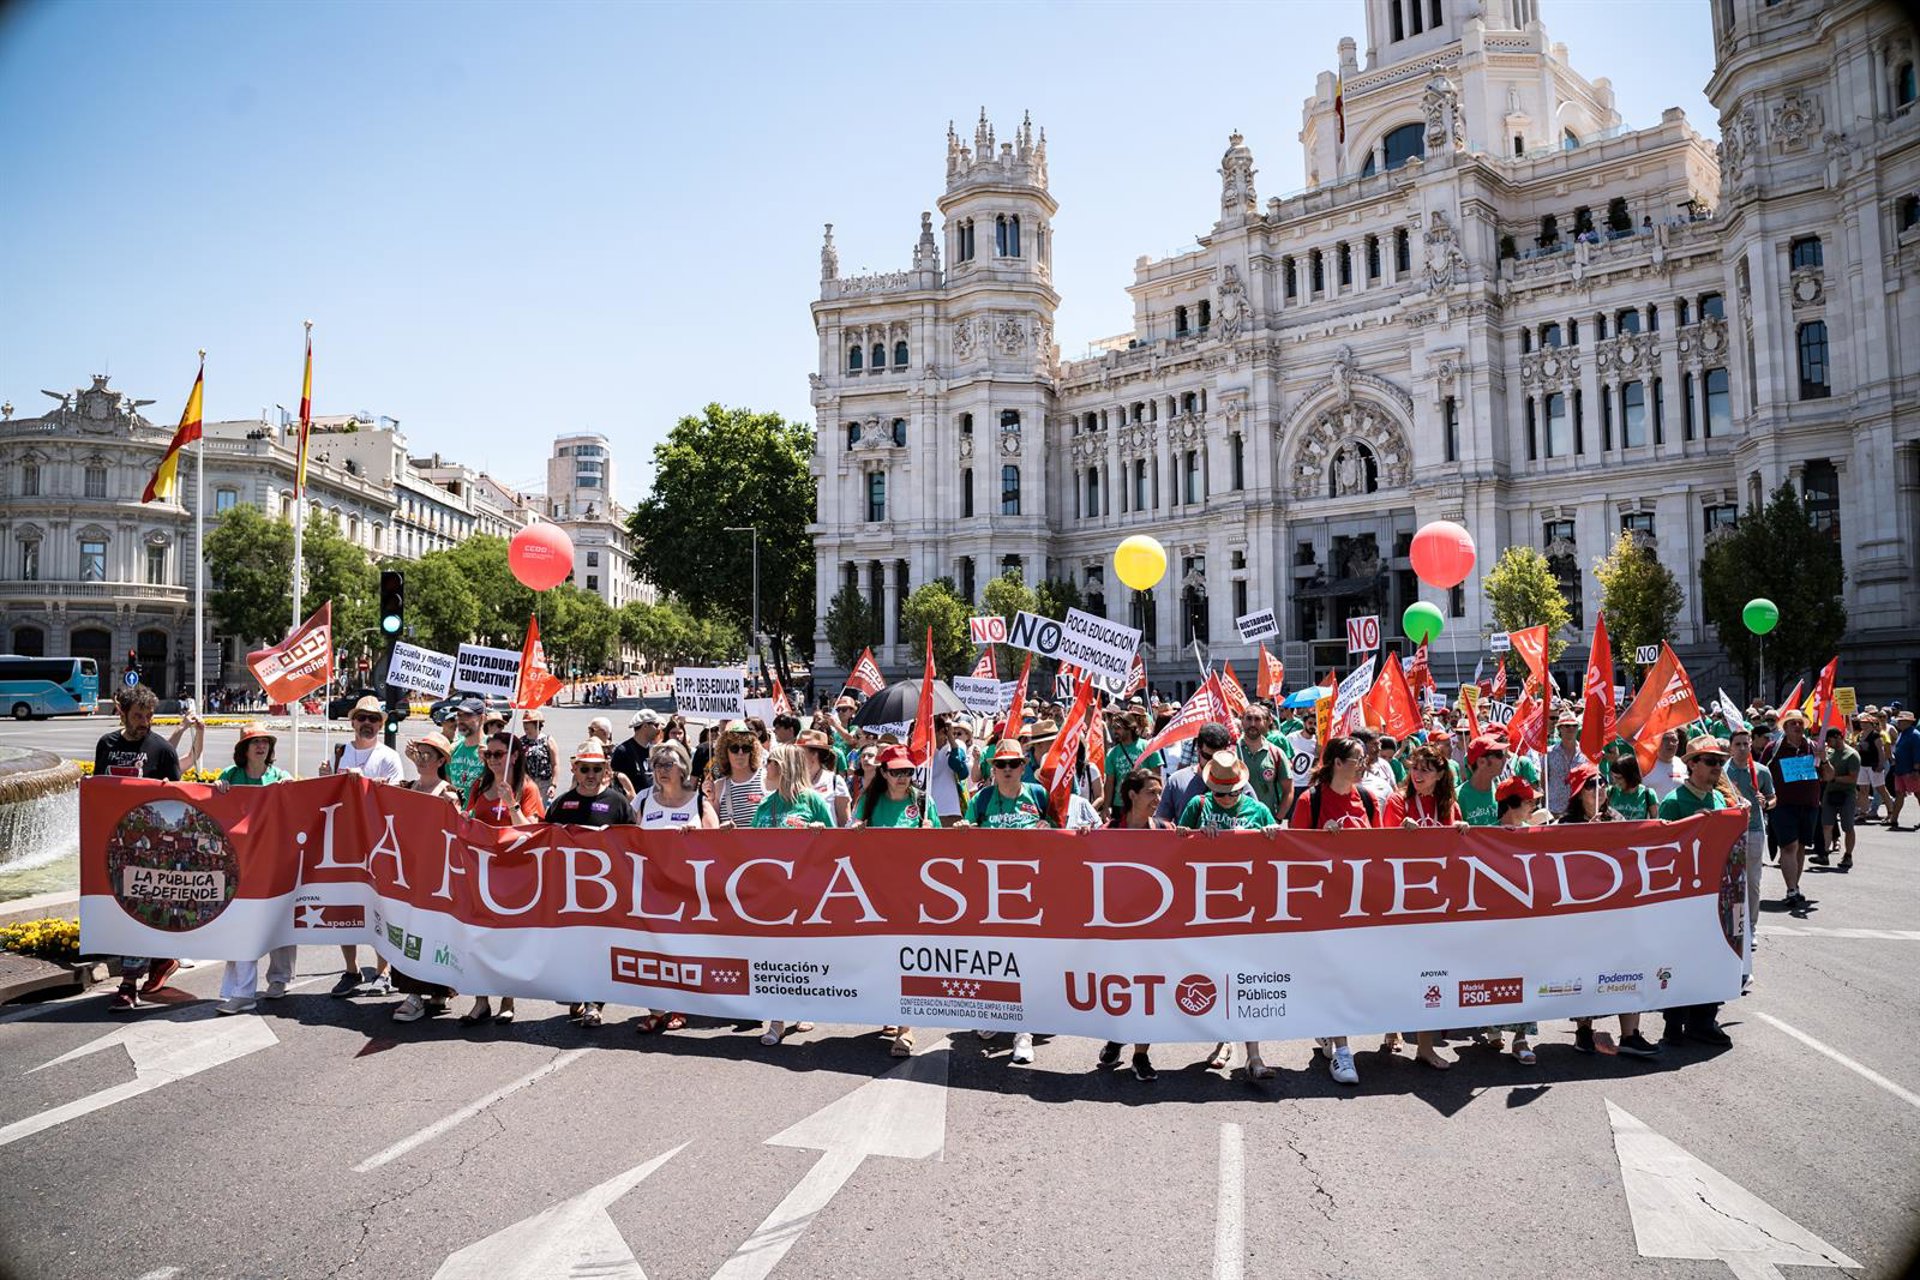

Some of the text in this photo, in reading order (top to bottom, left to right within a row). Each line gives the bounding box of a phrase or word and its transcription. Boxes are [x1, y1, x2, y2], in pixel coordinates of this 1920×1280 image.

[971, 618, 1005, 642] NO
[1011, 612, 1062, 654] NO
[1066, 614, 1088, 636] POCA
[1348, 617, 1379, 651] NO
[394, 644, 454, 669] Escuela y medios:
[1061, 637, 1081, 659] POCA
[1637, 646, 1657, 662] NO
[400, 660, 442, 679] PRIVATIZAN
[459, 652, 519, 673] DICTADURA
[390, 671, 445, 694] PARA ENGAÑAR
[684, 678, 695, 692] PP:
[696, 678, 740, 694] DES-EDUCAR
[955, 682, 971, 692] Piden
[677, 696, 741, 713] PARA DOMINAR.
[1490, 702, 1515, 726] NO
[135, 870, 214, 887] LA PÚBLICA
[918, 857, 1044, 926] SE
[1083, 839, 1703, 927] DEFIENDE!
[131, 884, 218, 899] SE DEFIENDE
[617, 954, 702, 986] CCOO
[753, 961, 829, 975] educación y
[900, 946, 1021, 978] CONFAPA
[754, 971, 810, 984] servicios
[1237, 971, 1291, 984] Servicios
[1598, 972, 1644, 984] Podemos
[755, 984, 858, 998] socioeducativos
[1064, 971, 1166, 1016] UGT
[1237, 988, 1287, 1001] Públicos
[1606, 983, 1636, 992] Madrid
[1462, 991, 1492, 1004] PSOE
[901, 1006, 1023, 1021] DE LA COMUNIDAD DE MADRID
[1237, 1003, 1286, 1019] Madrid
